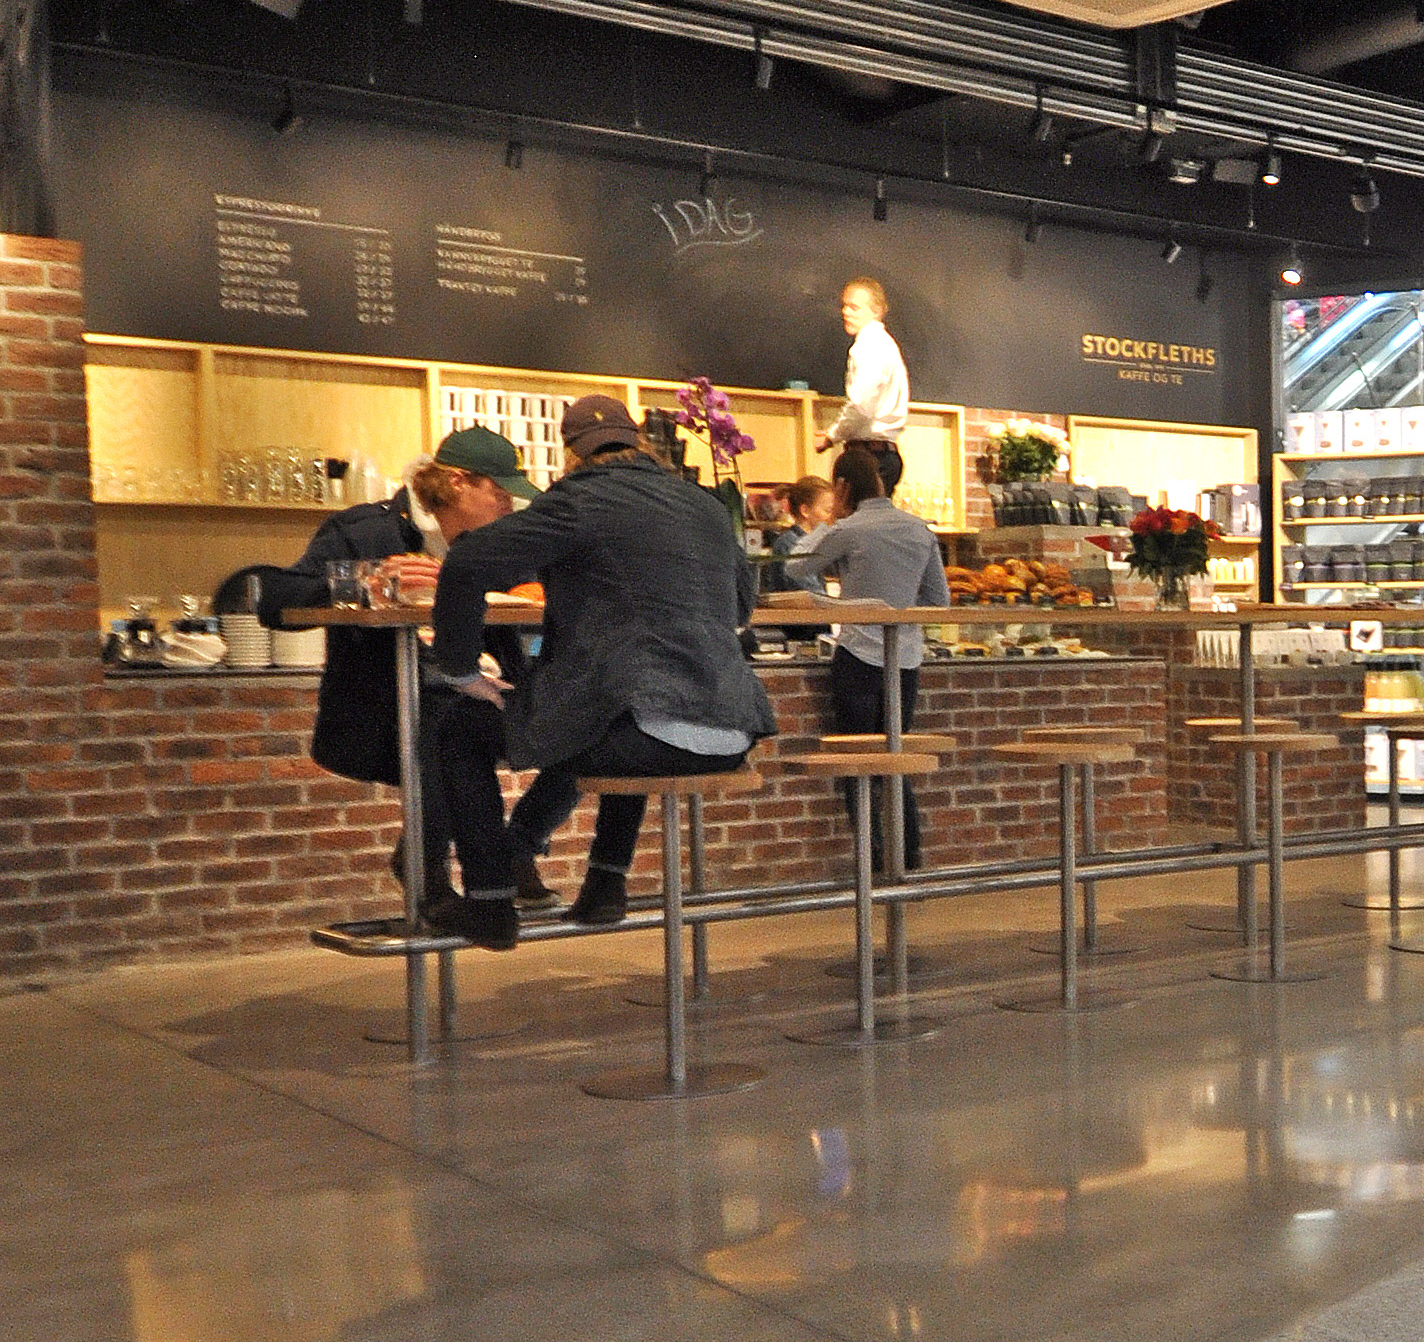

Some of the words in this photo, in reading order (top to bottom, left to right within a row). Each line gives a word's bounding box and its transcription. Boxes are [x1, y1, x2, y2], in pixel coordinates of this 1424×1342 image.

[1081, 333, 1216, 367] STOCKFLETHS
[1118, 369, 1150, 382] KAFFE
[1153, 371, 1168, 384] OG
[1171, 373, 1184, 386] TE
